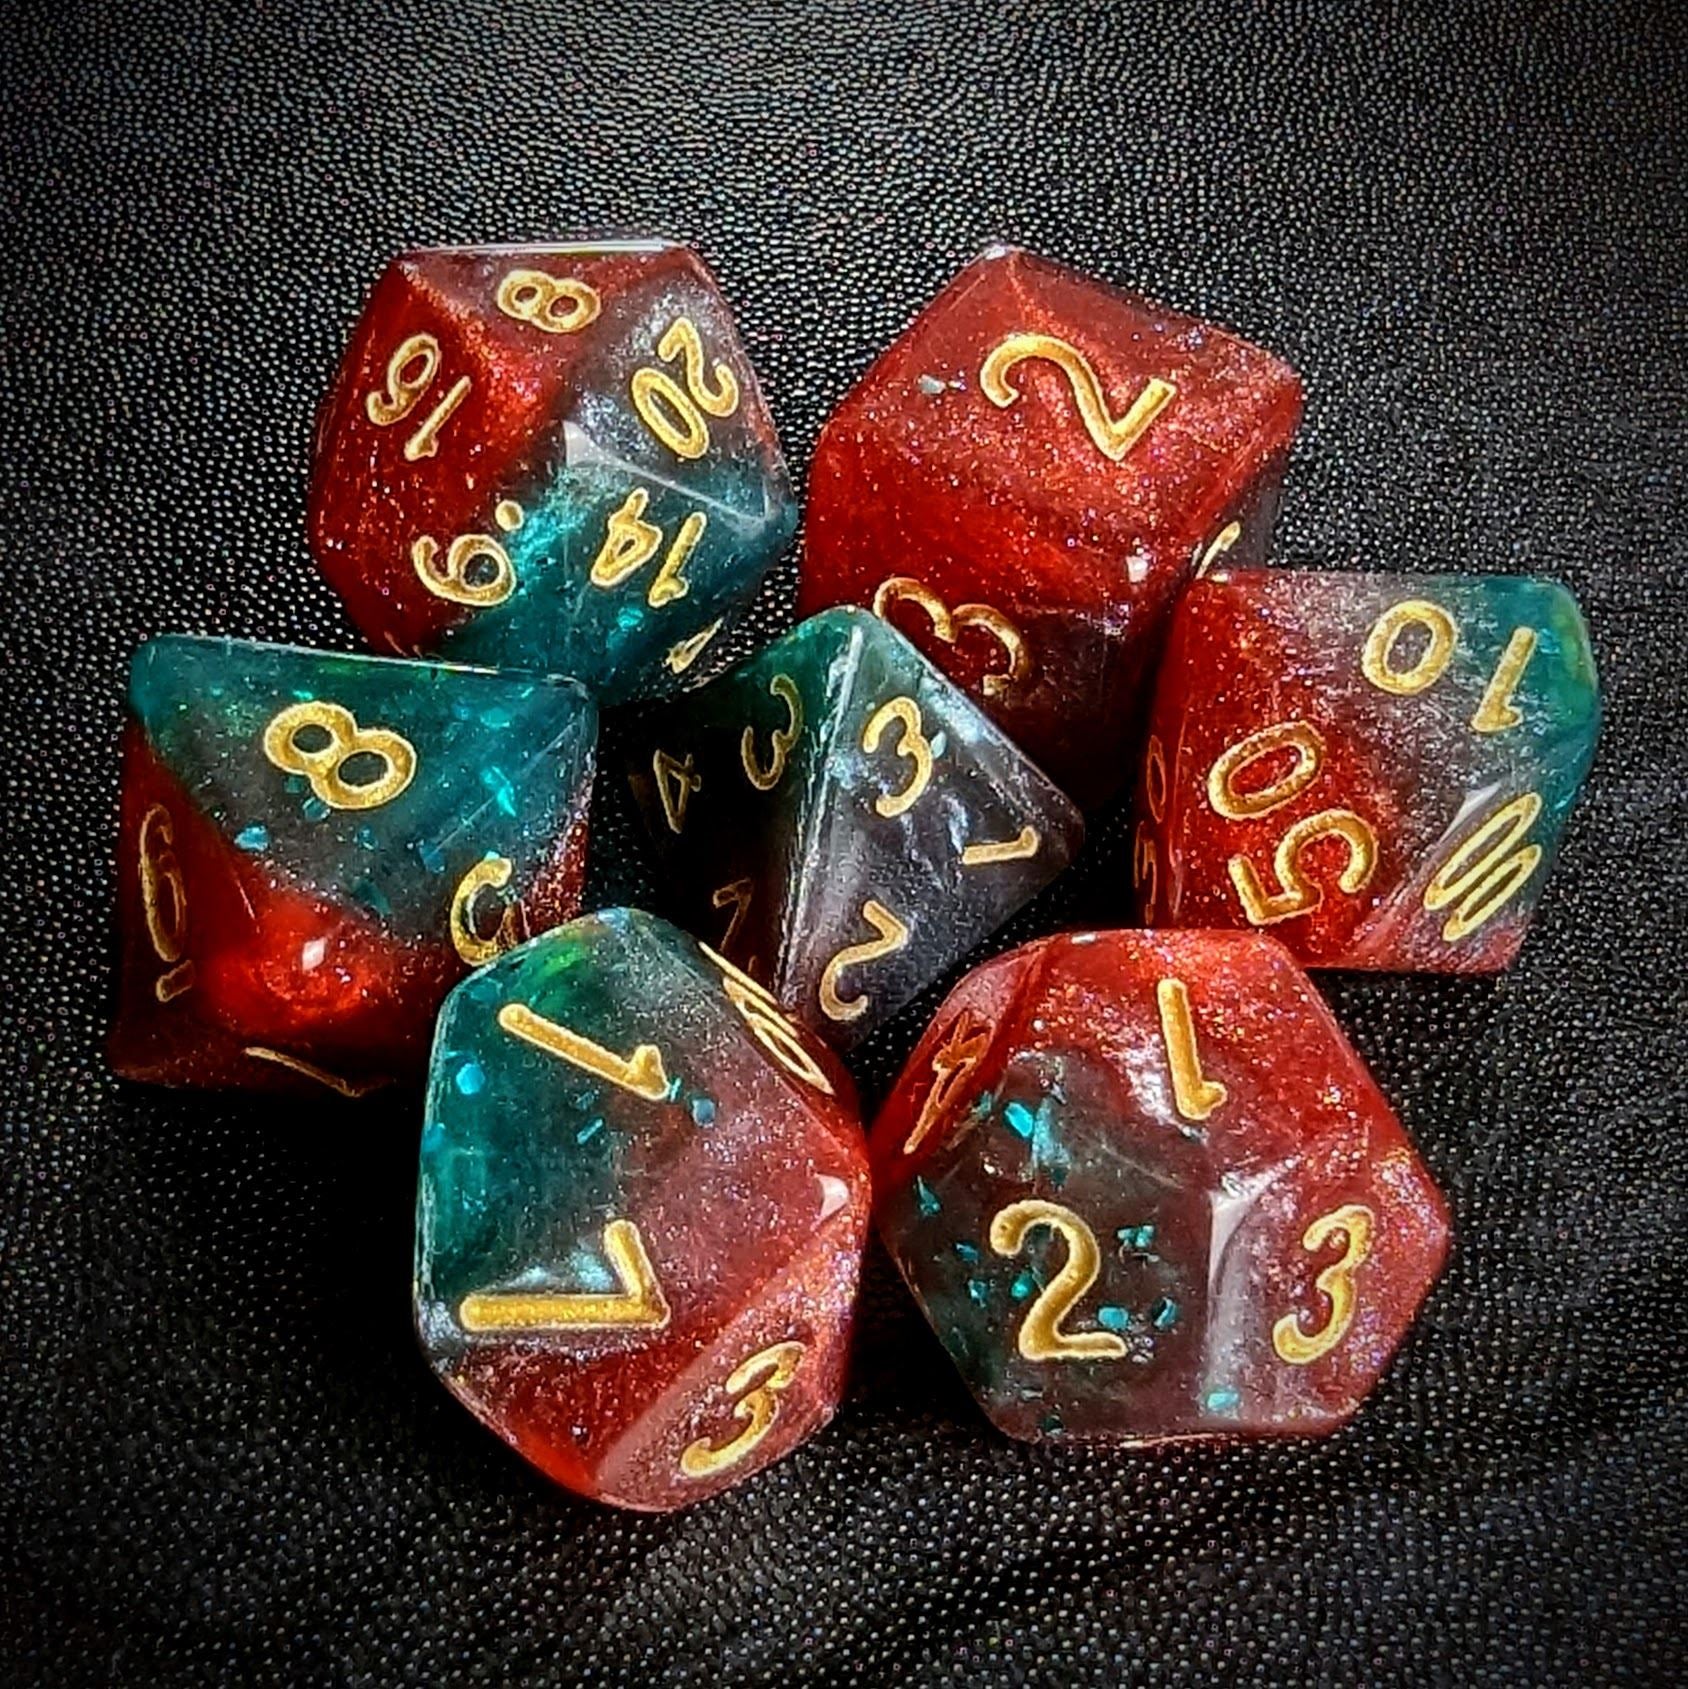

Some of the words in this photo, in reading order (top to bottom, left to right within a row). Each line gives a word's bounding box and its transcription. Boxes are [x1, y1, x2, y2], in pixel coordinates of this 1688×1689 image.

[498, 269, 601, 332] 8
[366, 333, 472, 462] 16
[631, 317, 739, 459] 20
[980, 334, 1177, 461] 2
[590, 487, 706, 608] 14
[873, 577, 1029, 695] 3
[1362, 600, 1538, 733] 10
[264, 700, 417, 810] 8
[741, 674, 799, 791] 3
[862, 696, 933, 818] 3
[962, 825, 1038, 865] 1
[1207, 720, 1380, 926] 50
[1424, 793, 1542, 941] 00
[820, 900, 908, 1021] 2
[498, 1003, 669, 1100] 1
[1156, 978, 1227, 1121] 1
[460, 1219, 670, 1331] 7
[990, 1200, 1127, 1361] 2
[1273, 1204, 1375, 1364] 3
[681, 1340, 804, 1479] 3
